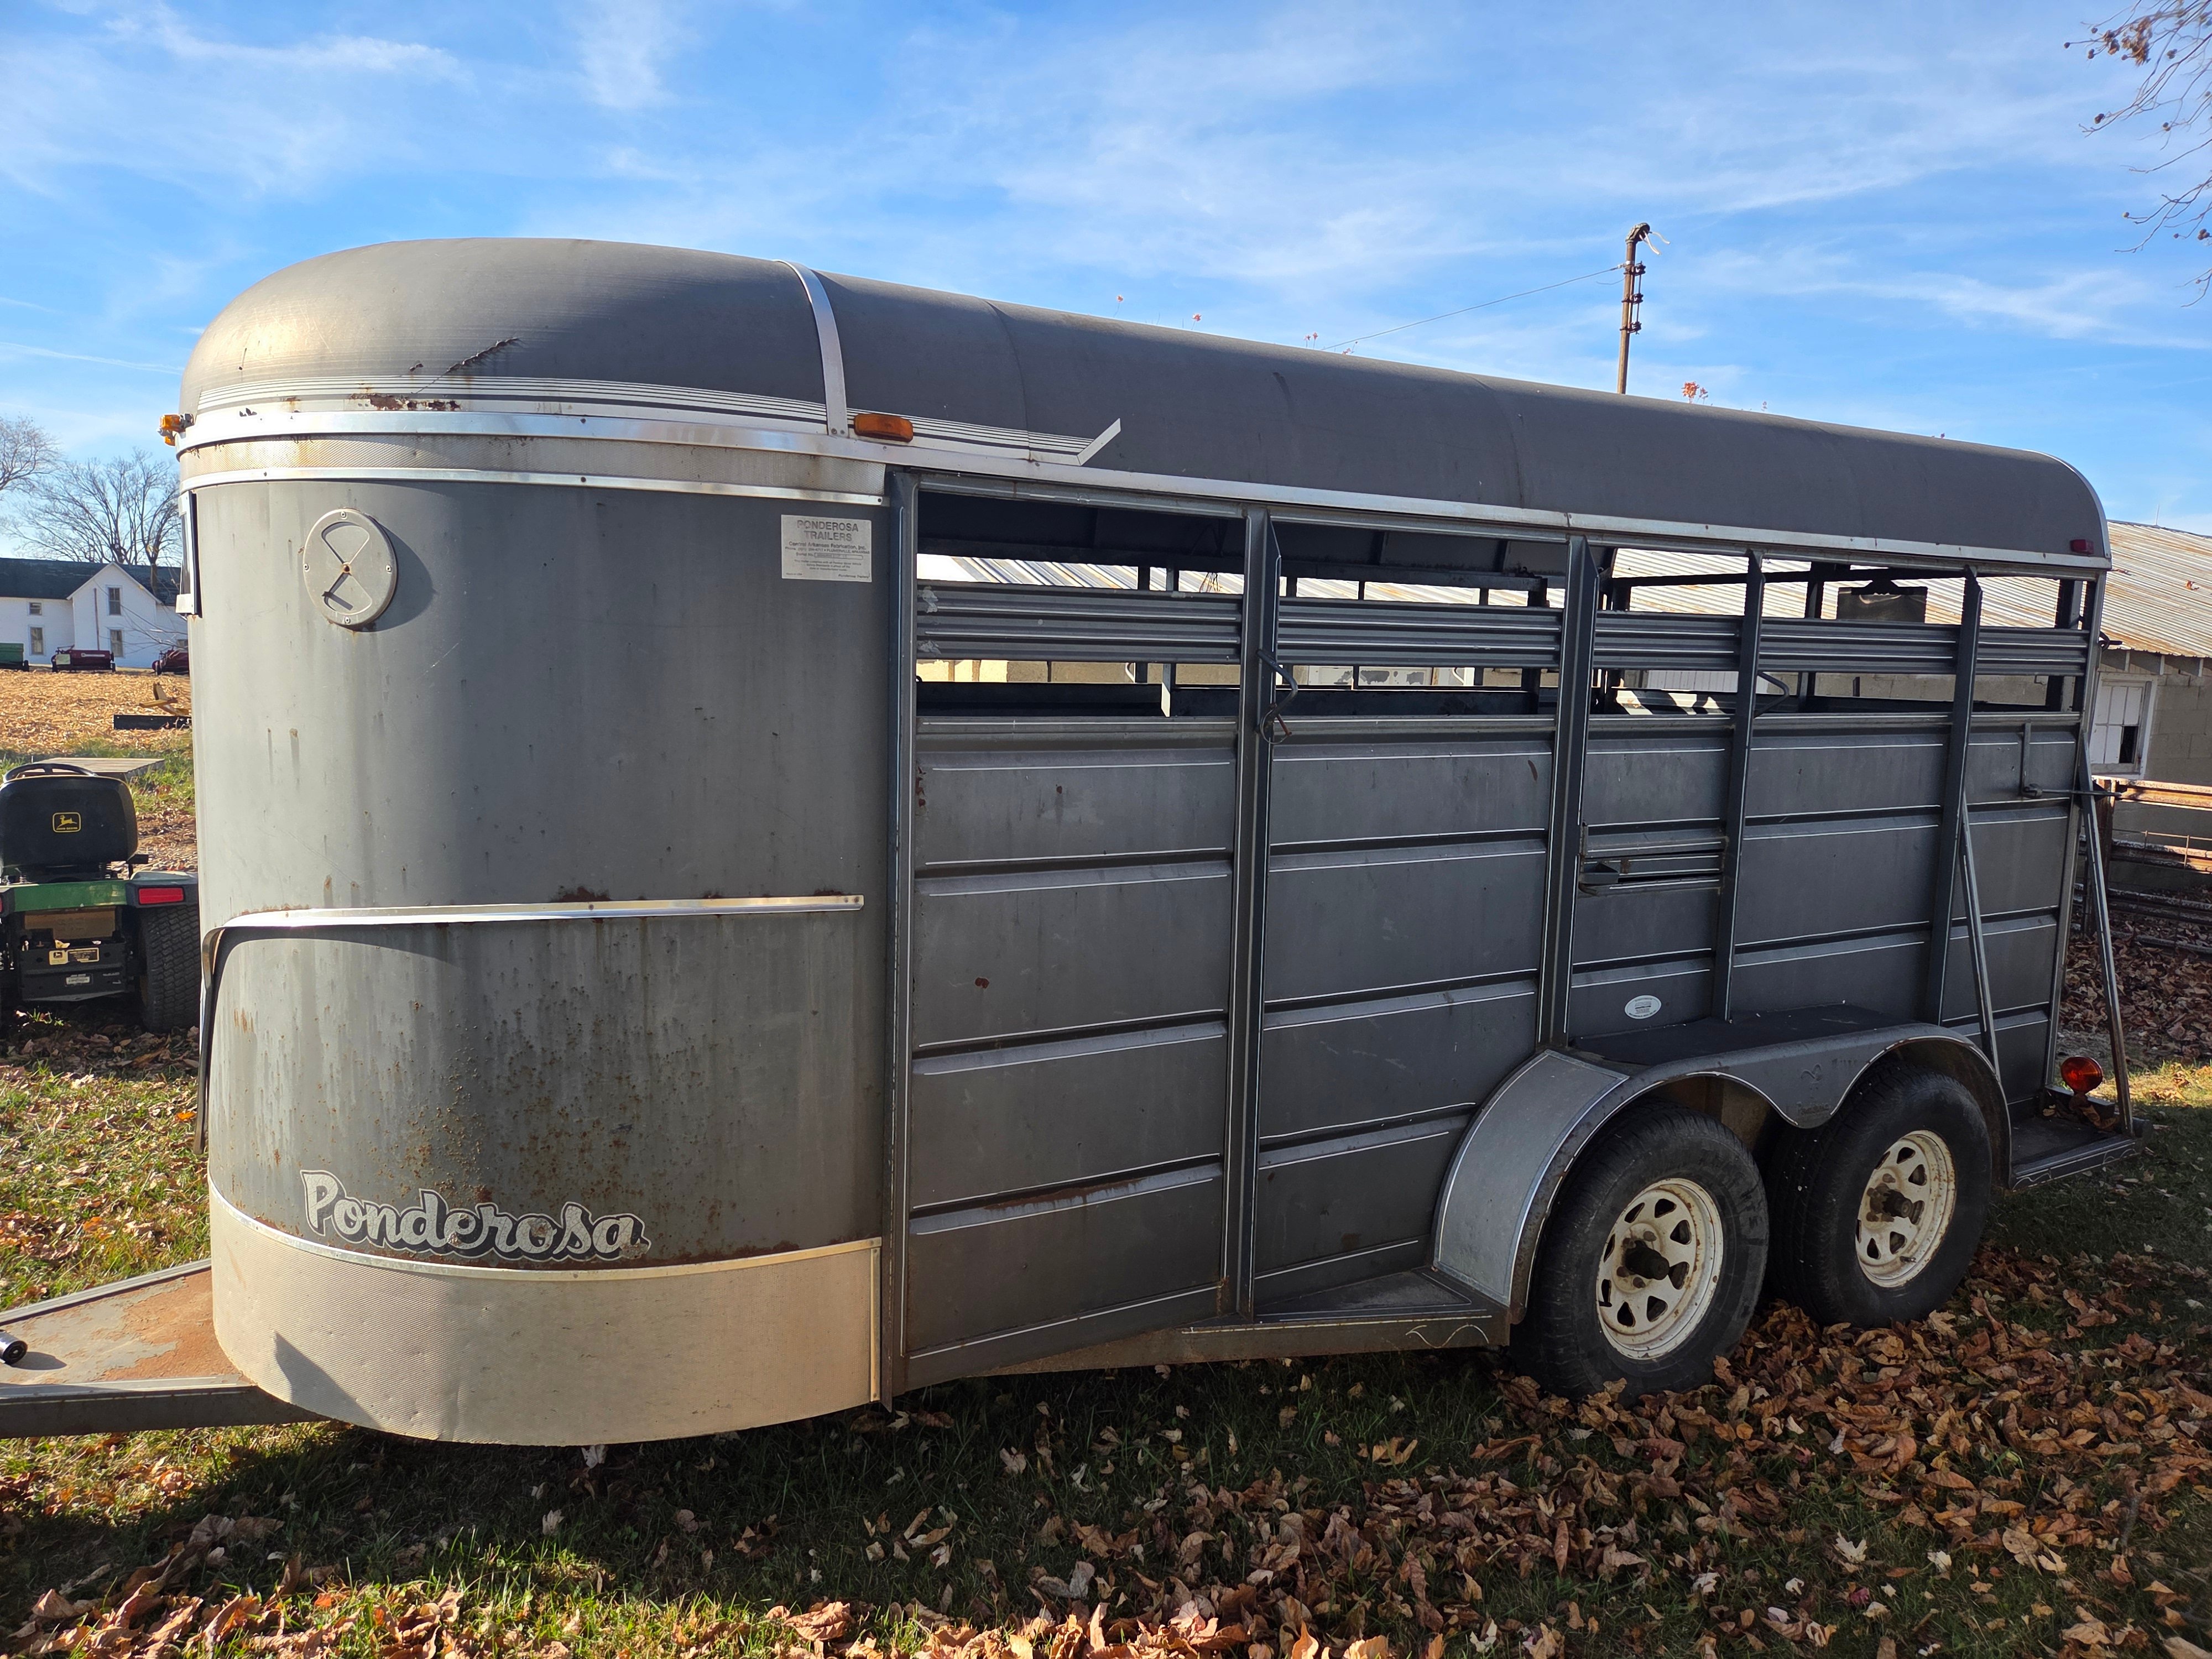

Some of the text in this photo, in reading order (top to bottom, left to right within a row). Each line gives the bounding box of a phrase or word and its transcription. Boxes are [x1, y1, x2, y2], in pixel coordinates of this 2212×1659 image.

[797, 520, 859, 532] PONDEROSA
[804, 530, 852, 541] TRAILERS
[300, 1170, 652, 1261] Ponderosa
